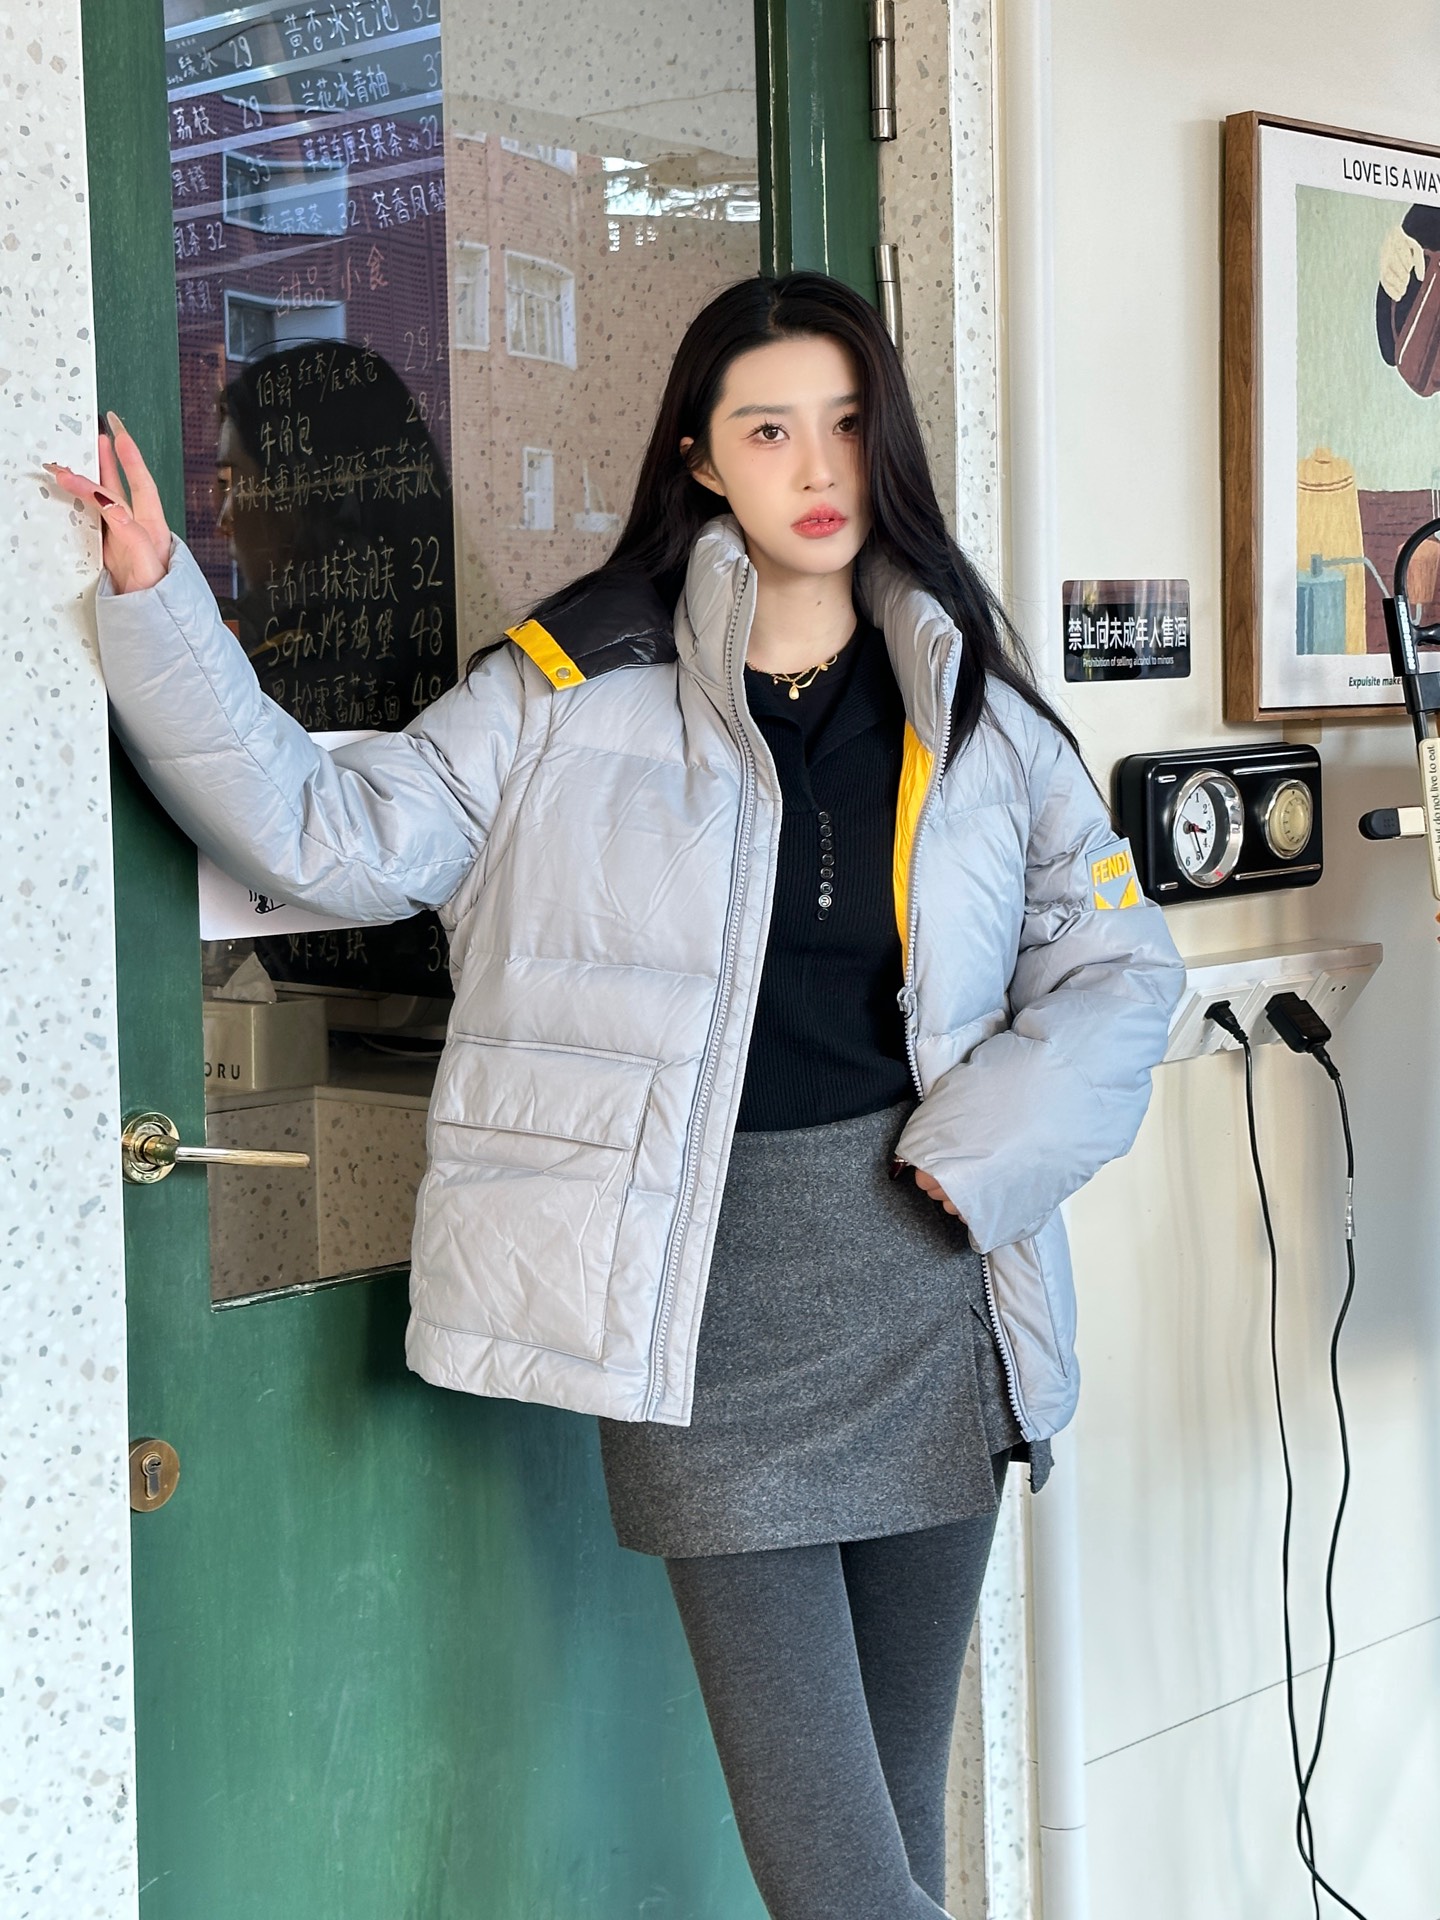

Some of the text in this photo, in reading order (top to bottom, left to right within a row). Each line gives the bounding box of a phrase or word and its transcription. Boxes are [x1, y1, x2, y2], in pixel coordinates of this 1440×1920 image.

[229, 36, 253, 68] 29
[168, 95, 263, 141] 荔枝 29
[419, 115, 443, 150] 32
[1343, 158, 1382, 185] LOVE
[1385, 165, 1399, 187] IS
[1402, 168, 1412, 190] A
[338, 200, 360, 229] 32
[206, 221, 227, 251] 32
[260, 412, 313, 465] 牛角包
[411, 536, 443, 591] 32
[409, 606, 443, 657] 48
[1068, 616, 1187, 651] 禁止向未成年人售酒
[1082, 655, 1175, 668] Prohibition of selling alcohol to minors
[1429, 762, 1437, 773] to
[1430, 776, 1438, 792] live
[1202, 803, 1208, 814] 2
[1092, 850, 1132, 886] FENDI
[1185, 857, 1191, 867] 6
